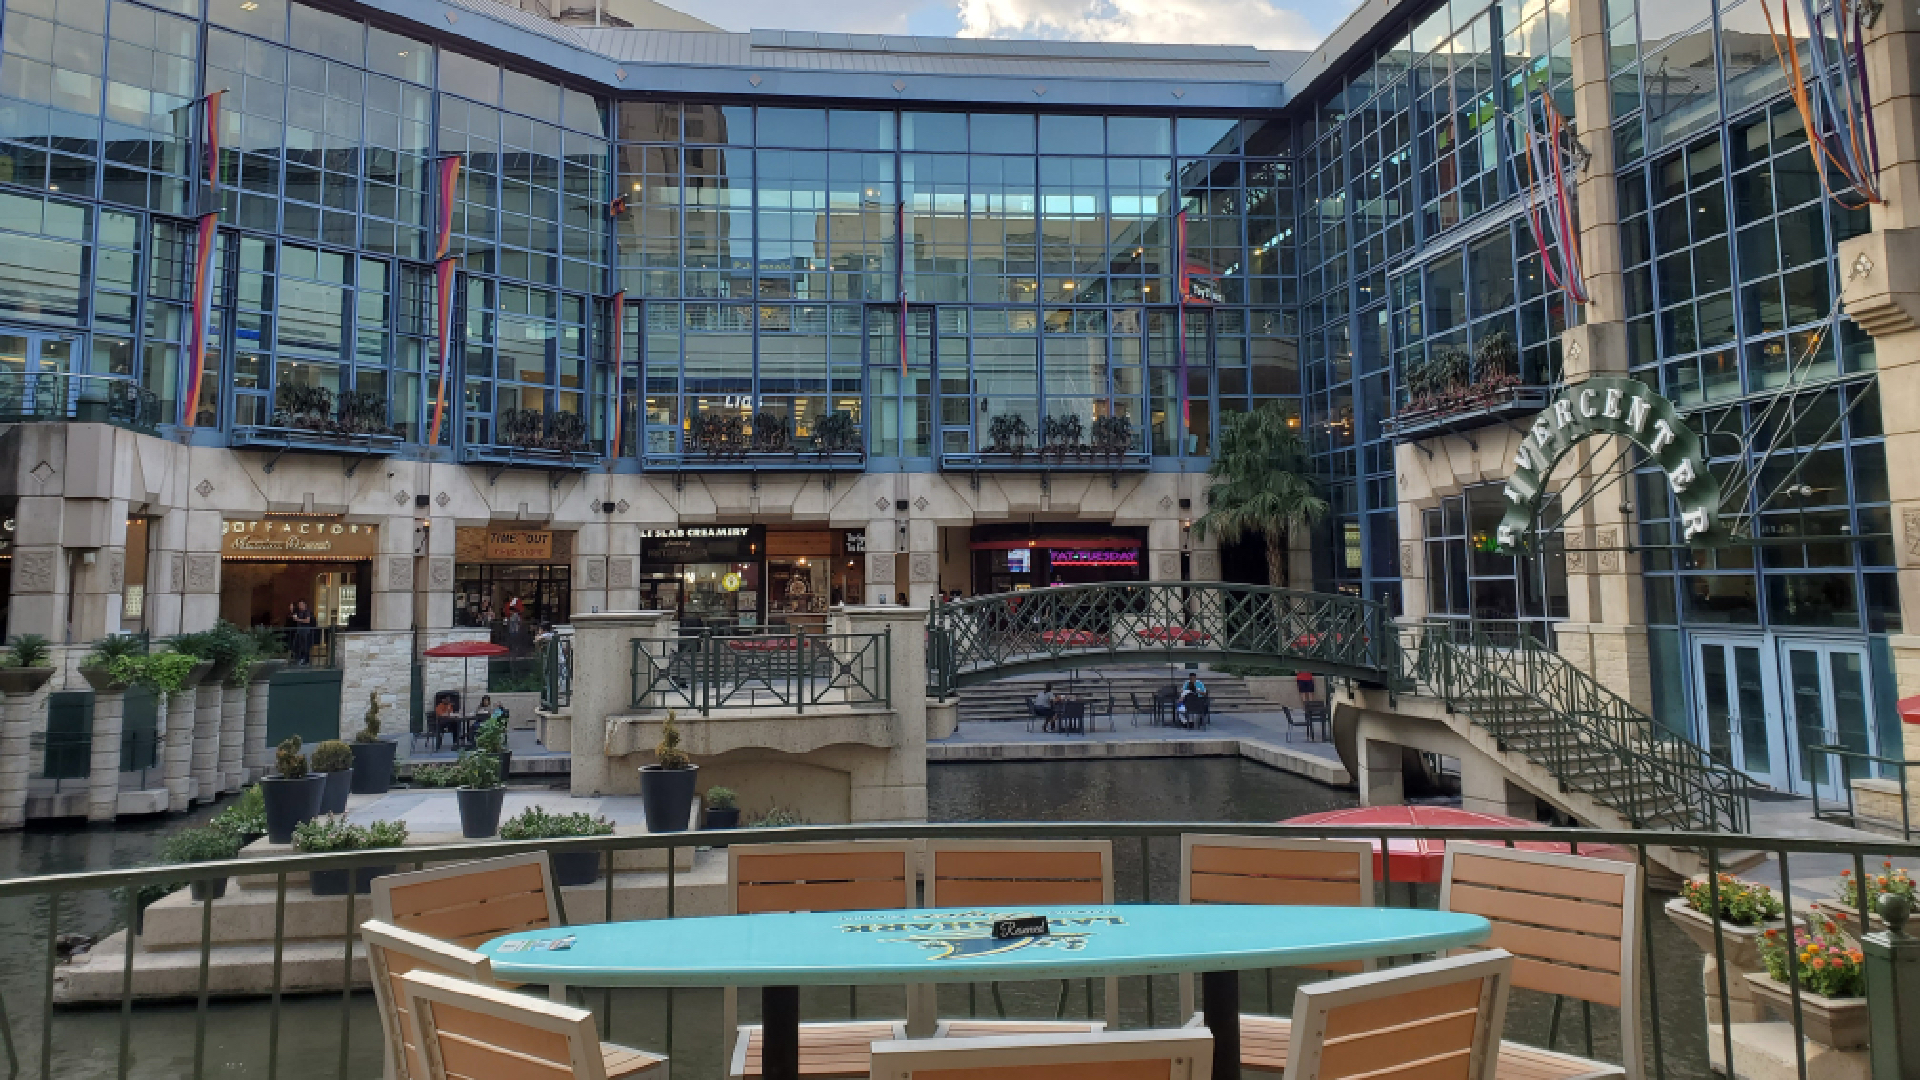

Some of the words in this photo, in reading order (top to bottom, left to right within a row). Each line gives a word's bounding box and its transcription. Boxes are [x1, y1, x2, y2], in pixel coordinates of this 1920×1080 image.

[1496, 387, 1711, 547] RIVERCENTER
[264, 522, 374, 537] FACTORY
[687, 528, 749, 538] CREAMERY
[490, 532, 517, 544] TIME
[526, 534, 550, 545] OUT
[1050, 550, 1074, 561] FAT
[1077, 550, 1137, 561] TUESDAY
